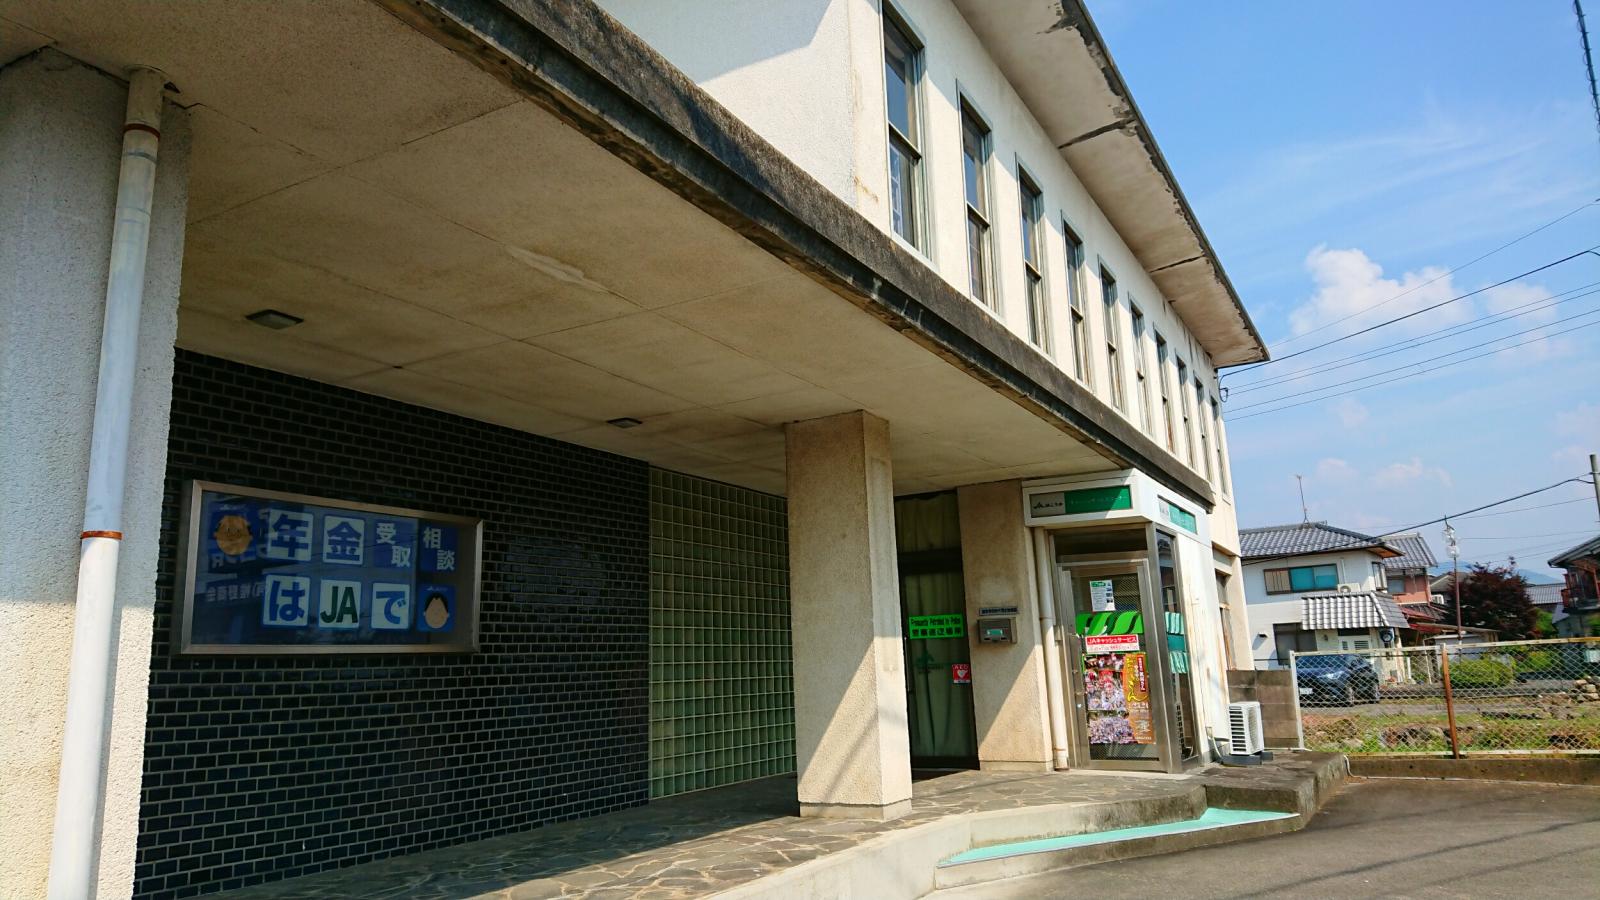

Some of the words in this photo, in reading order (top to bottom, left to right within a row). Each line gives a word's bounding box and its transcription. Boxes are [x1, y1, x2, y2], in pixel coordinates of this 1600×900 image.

[1088, 636, 1137, 645] JAキャッシュサービス
